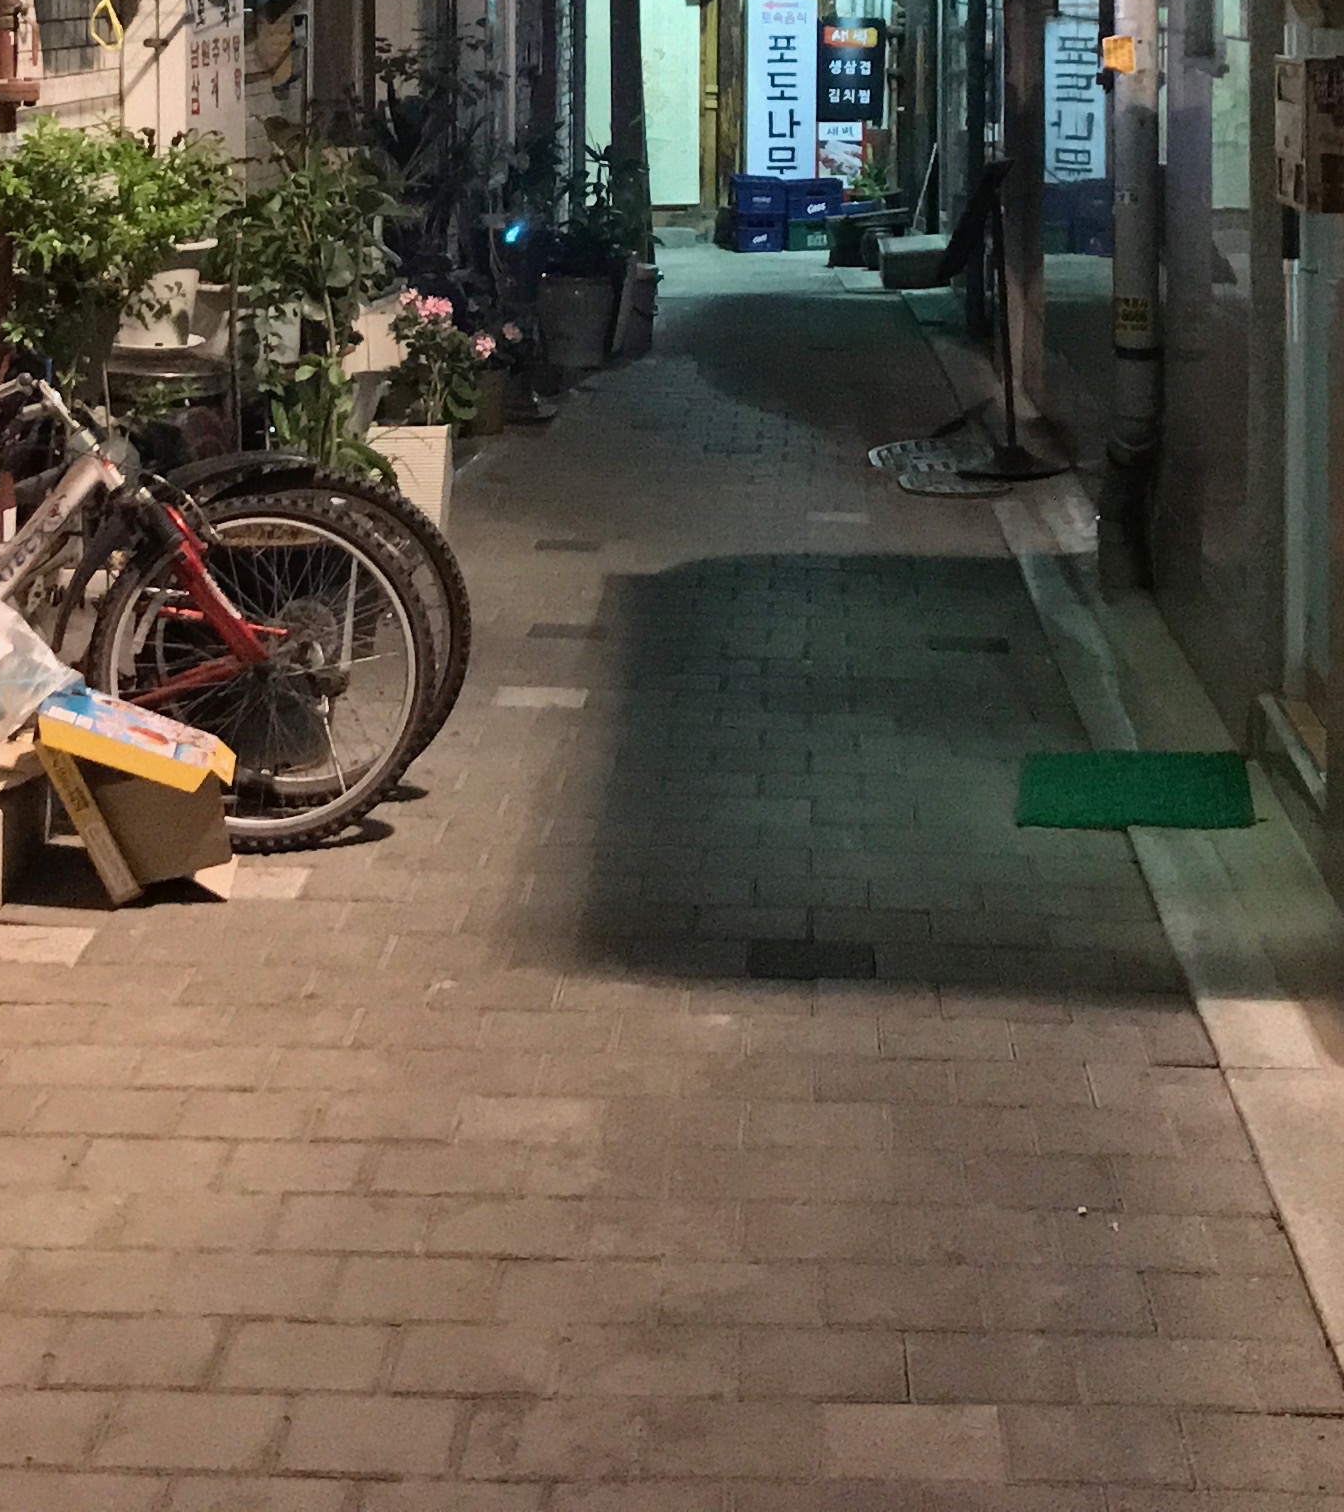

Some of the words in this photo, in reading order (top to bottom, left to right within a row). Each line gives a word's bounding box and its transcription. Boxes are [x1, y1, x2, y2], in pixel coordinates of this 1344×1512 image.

[828, 59, 872, 76] 생삼겹
[766, 34, 802, 176] 포도나무
[828, 87, 871, 105] 김치찜
